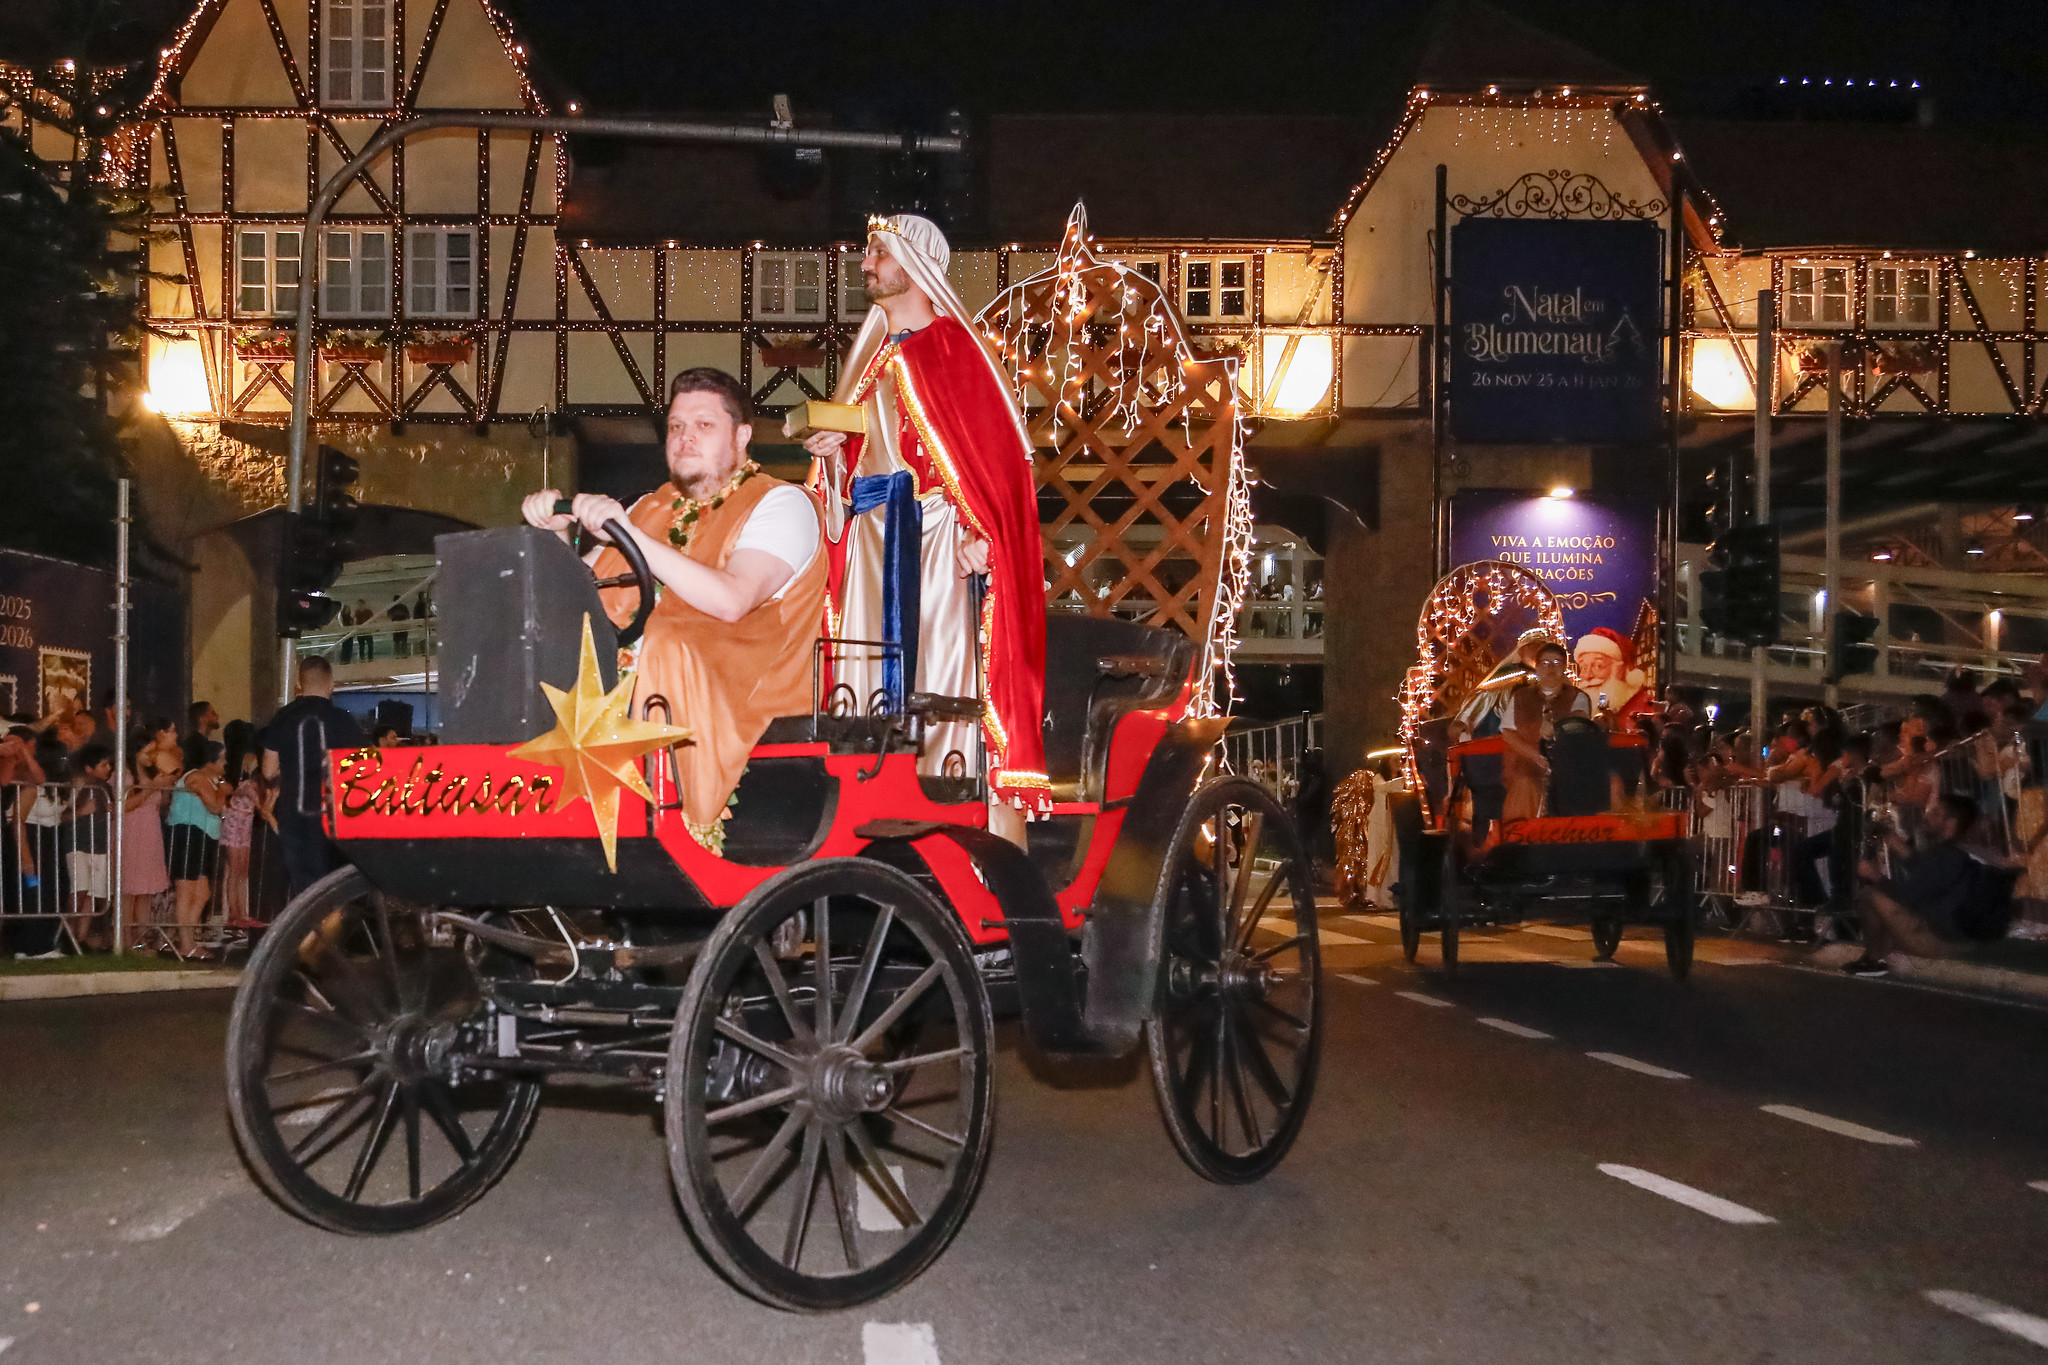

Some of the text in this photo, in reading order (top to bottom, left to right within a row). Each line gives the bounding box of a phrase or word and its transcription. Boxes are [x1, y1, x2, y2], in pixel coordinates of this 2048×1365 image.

[1501, 284, 1605, 325] Natal em
[1463, 322, 1607, 363] Blumenau
[1471, 371, 1491, 387] 26
[1494, 372, 1532, 387] NOV
[1536, 372, 1554, 387] 25
[1491, 534, 1615, 551] VIVA A EMOÇÃO
[1499, 551, 1604, 565] QUE ILUMINA
[0, 594, 32, 620] 2025
[0, 625, 34, 649] 2026
[339, 747, 554, 817] Baltasar
